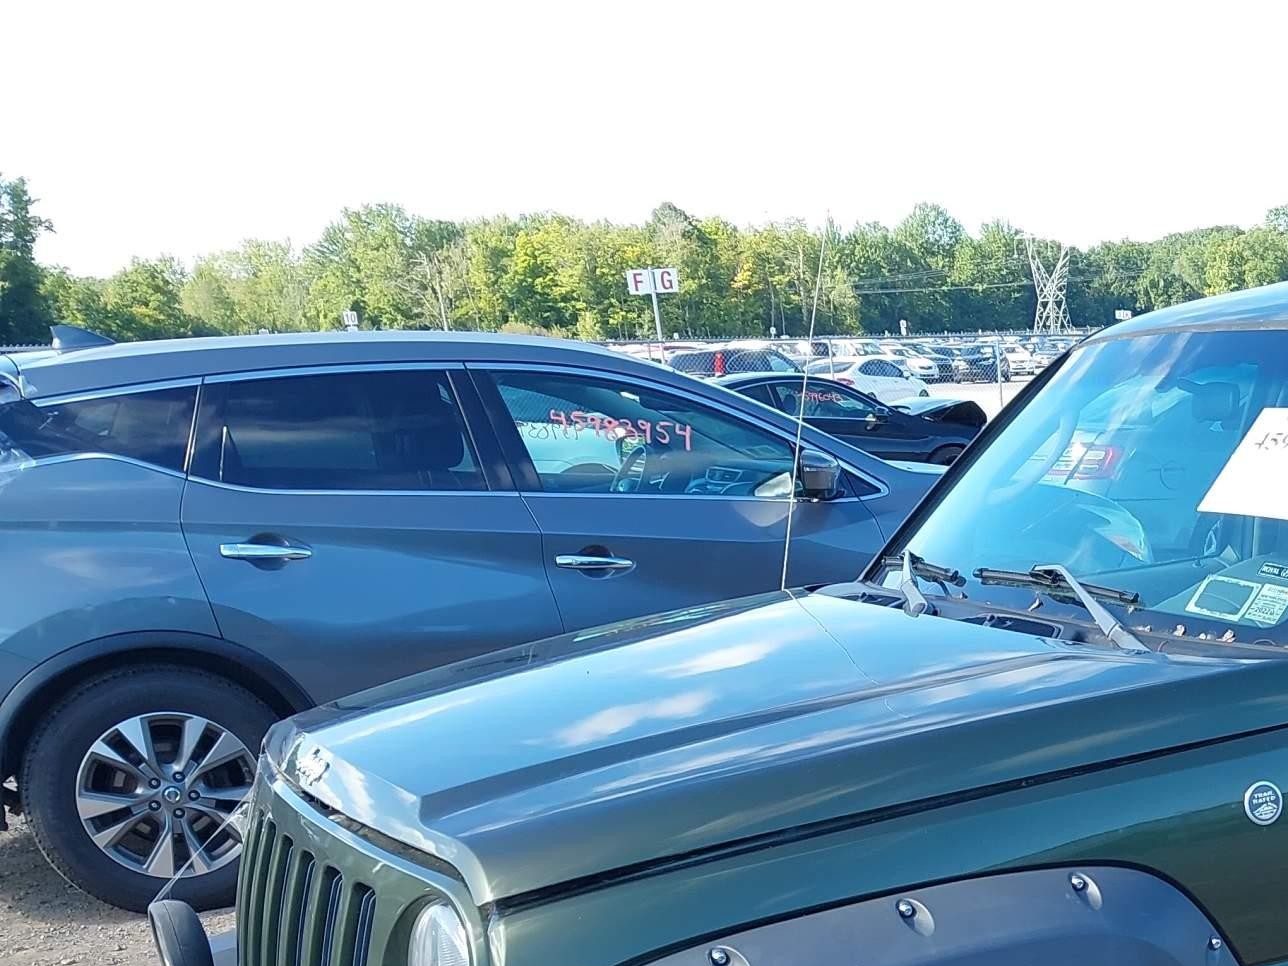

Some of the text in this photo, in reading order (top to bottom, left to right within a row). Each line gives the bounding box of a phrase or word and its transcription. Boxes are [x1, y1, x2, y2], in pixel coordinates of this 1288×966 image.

[632, 270, 674, 292] F G
[550, 409, 692, 451] 45983954
